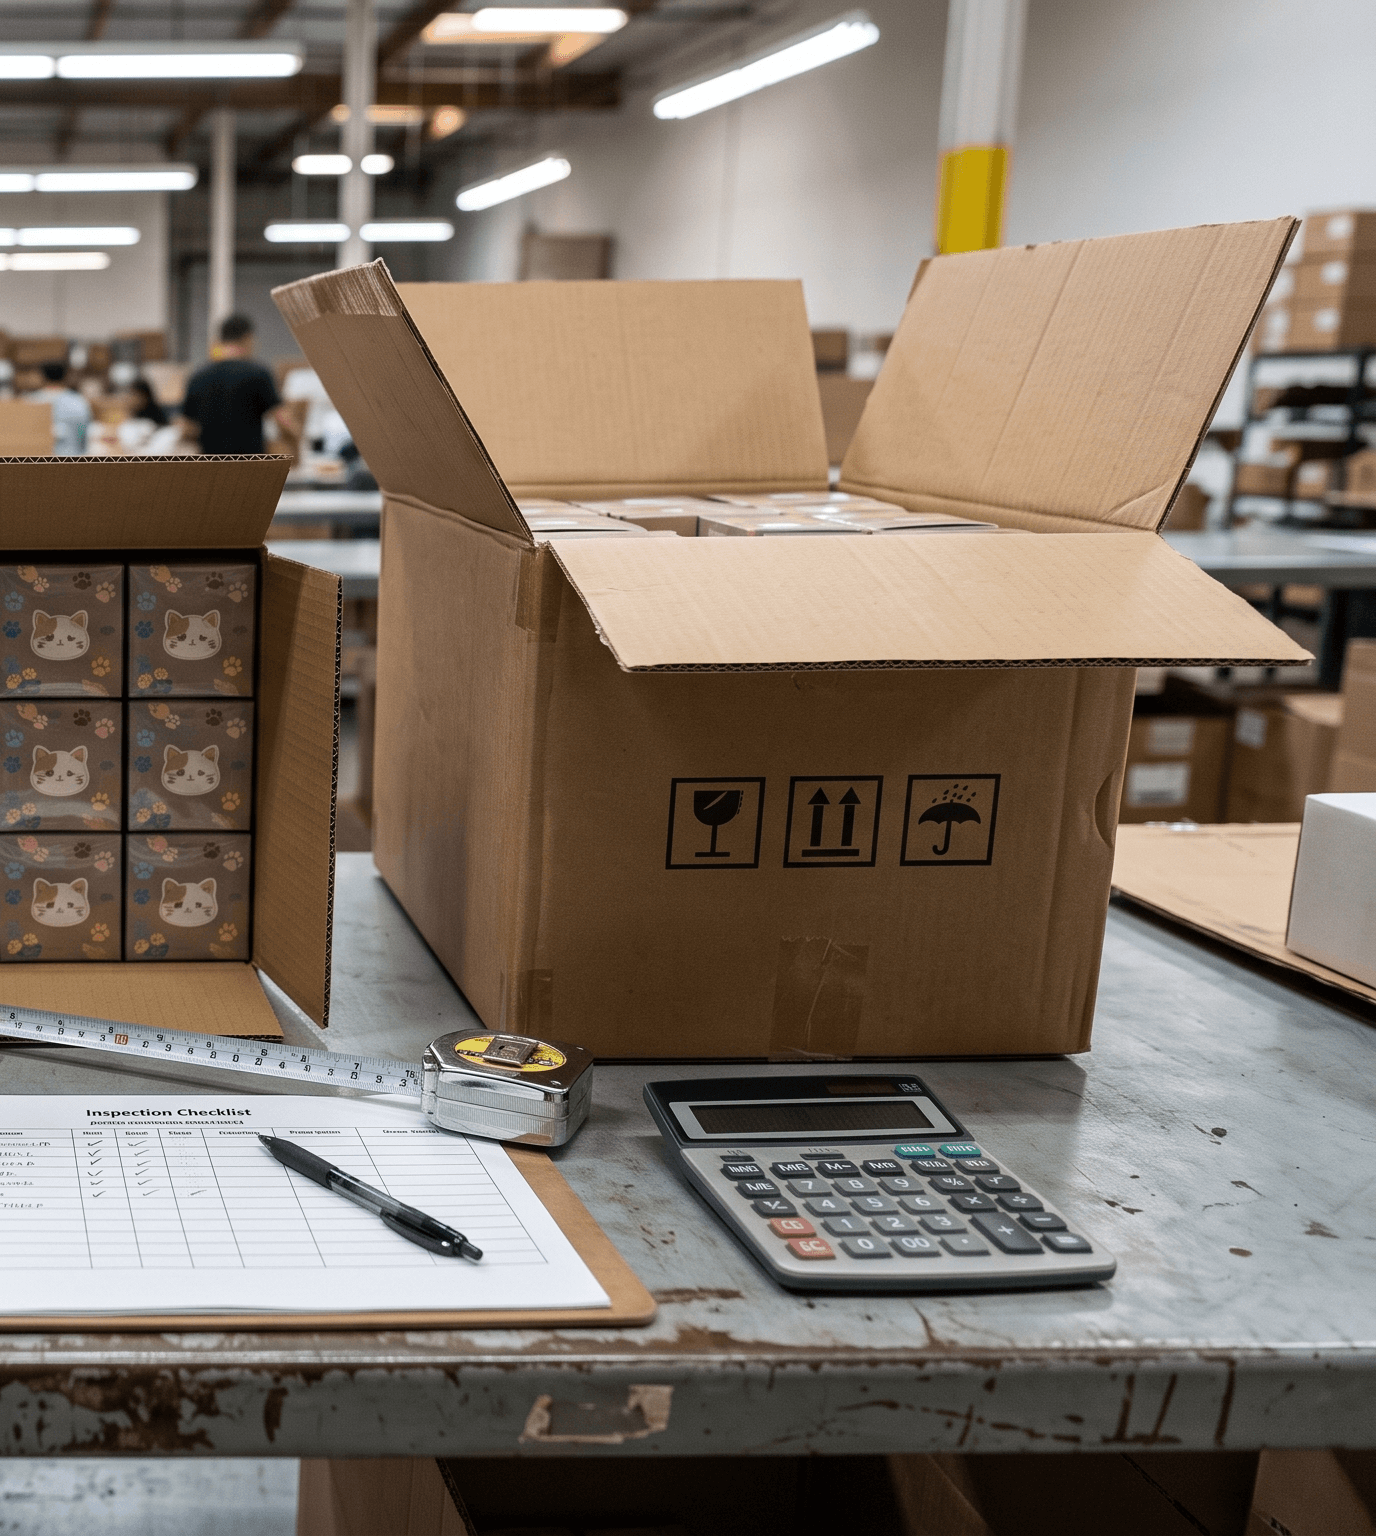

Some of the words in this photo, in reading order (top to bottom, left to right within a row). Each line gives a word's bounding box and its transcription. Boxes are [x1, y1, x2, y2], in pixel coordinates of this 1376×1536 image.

[86, 1108, 173, 1118] Inspection
[176, 1107, 252, 1117] Checklist
[800, 1180, 813, 1190] 7
[893, 1178, 910, 1188] 9
[866, 1197, 884, 1208] 5
[914, 1197, 931, 1207] 6
[840, 1218, 853, 1229] 1
[886, 1217, 905, 1228] 2
[934, 1215, 952, 1226] 3
[856, 1238, 874, 1250] 0
[901, 1237, 931, 1249] 00
